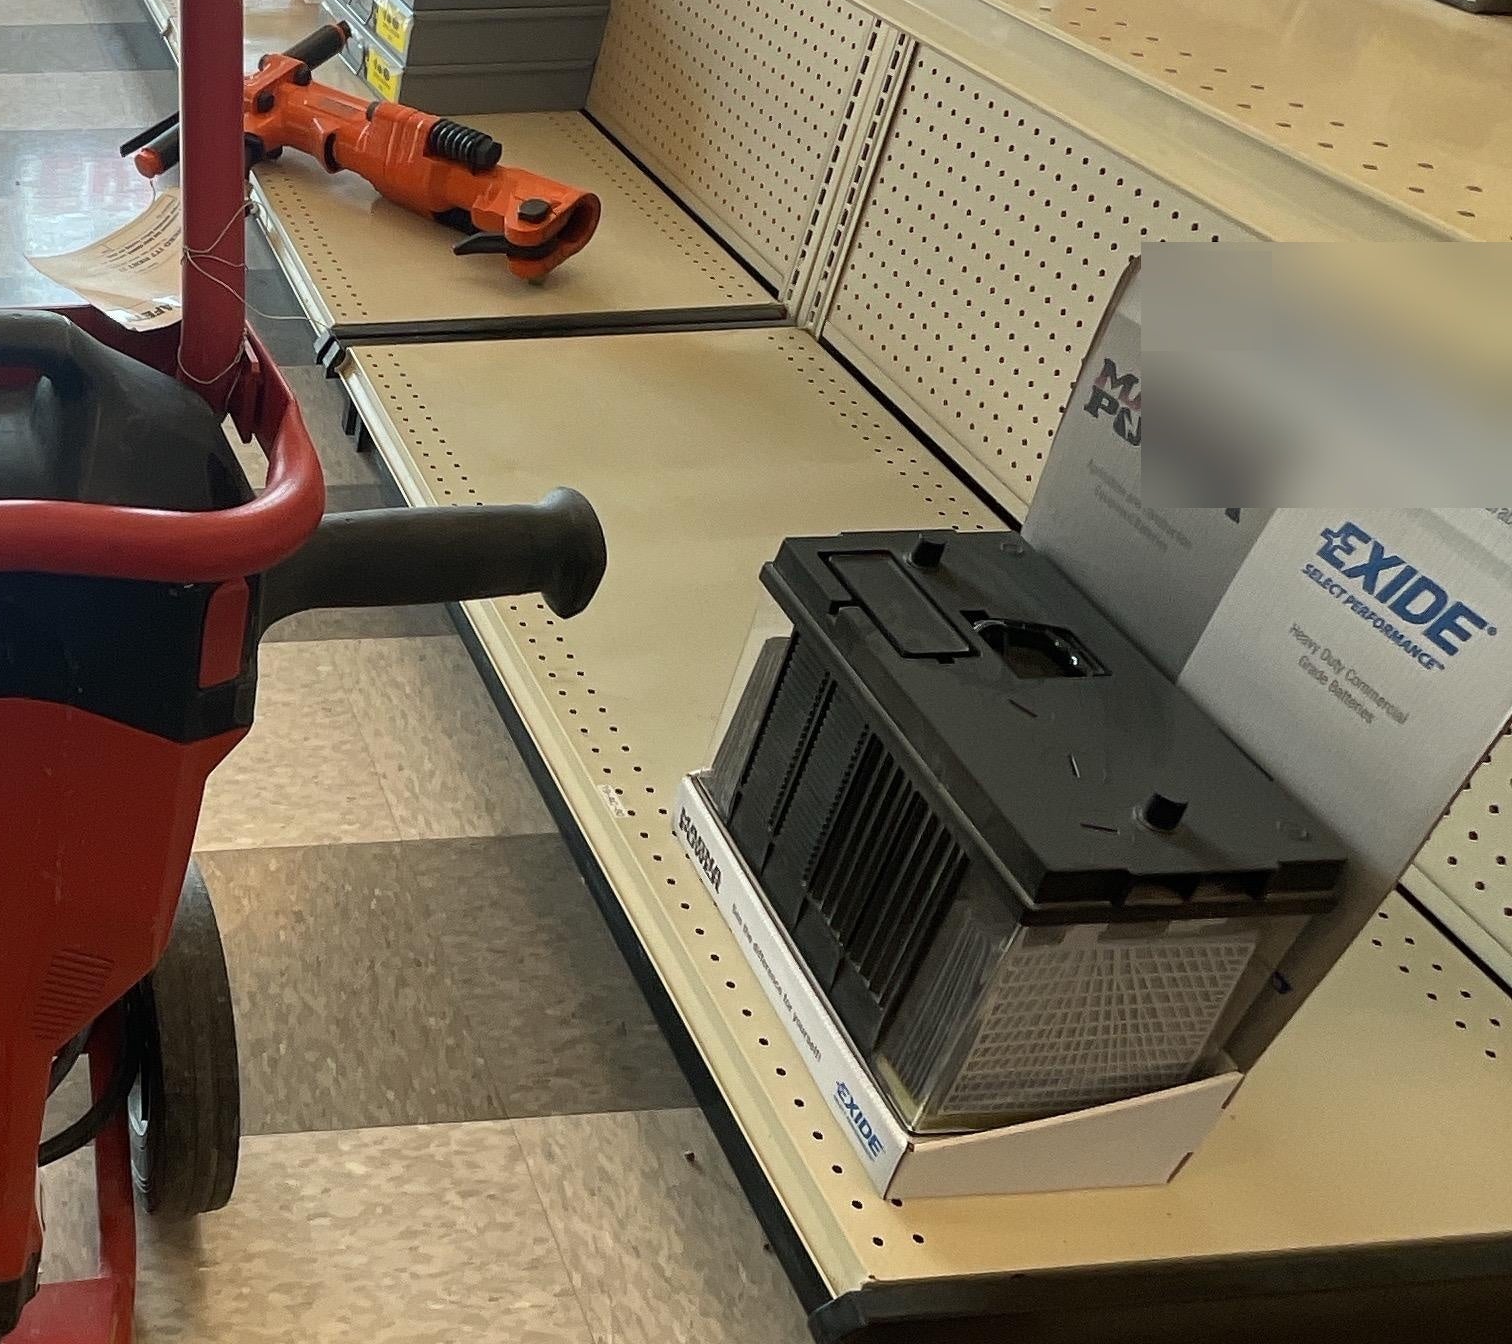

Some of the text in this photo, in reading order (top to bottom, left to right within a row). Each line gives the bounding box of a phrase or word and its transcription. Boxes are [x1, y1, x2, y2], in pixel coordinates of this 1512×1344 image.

[1301, 563, 1442, 670] SELECT PERFORMANCE
[1316, 520, 1490, 657] EXIDE
[1286, 623, 1411, 725] Heavy Duty Commercial
[1296, 654, 1379, 725] Grade Batteries
[836, 1081, 886, 1158] EXIDE
